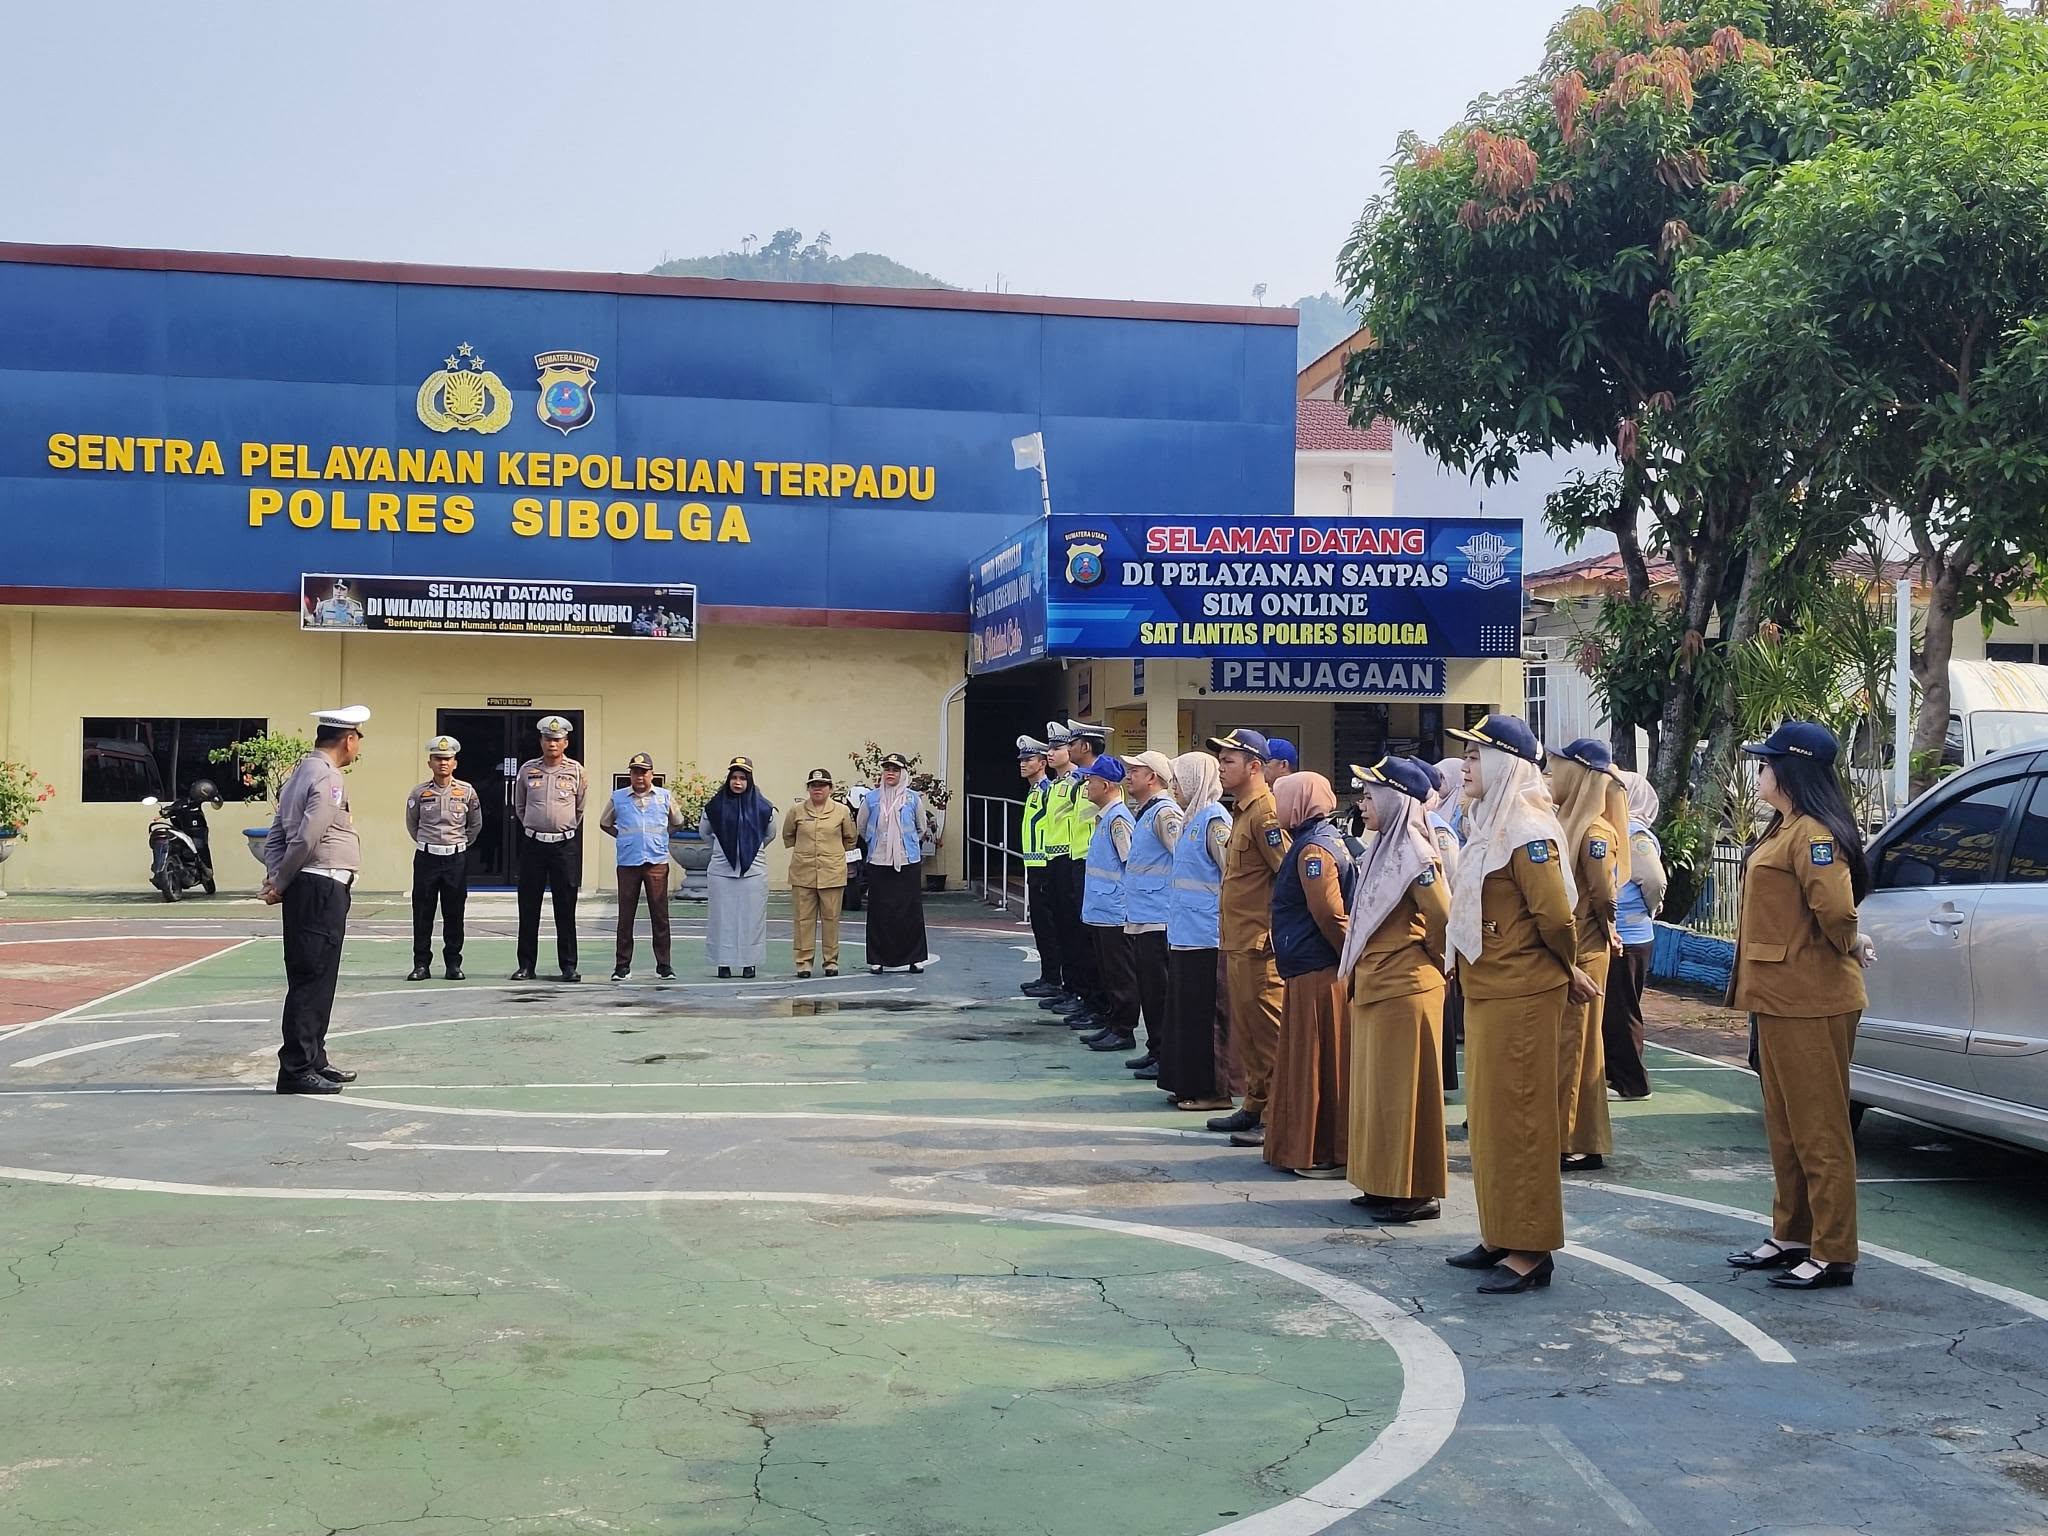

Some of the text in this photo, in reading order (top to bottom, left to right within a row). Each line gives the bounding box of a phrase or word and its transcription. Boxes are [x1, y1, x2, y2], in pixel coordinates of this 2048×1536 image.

[538, 353, 596, 367] SUMATERA UTARA
[48, 432, 936, 501] SENTRA PELAYANAN KEPOLISIAN TERPADU
[248, 488, 751, 543] POLRES SIBOLGA
[1147, 526, 1425, 555] SELAMAT DATANG
[1122, 562, 1448, 587] DI PELAYANAN SATPAS
[428, 583, 574, 601] SELAMAT DATANG
[1202, 593, 1368, 616] SIM ONLINE
[367, 598, 632, 623] DI WILAYAH BEBAS DARI KORUPSI (WBK)
[444, 620, 459, 629] dan
[461, 620, 497, 630] Humanis
[499, 621, 524, 631] dalam
[526, 622, 562, 633] Melayani
[1140, 622, 1428, 645] SAT LANTAS POLRES SIBOLGA
[1223, 661, 1433, 690] PENJAGAAN
